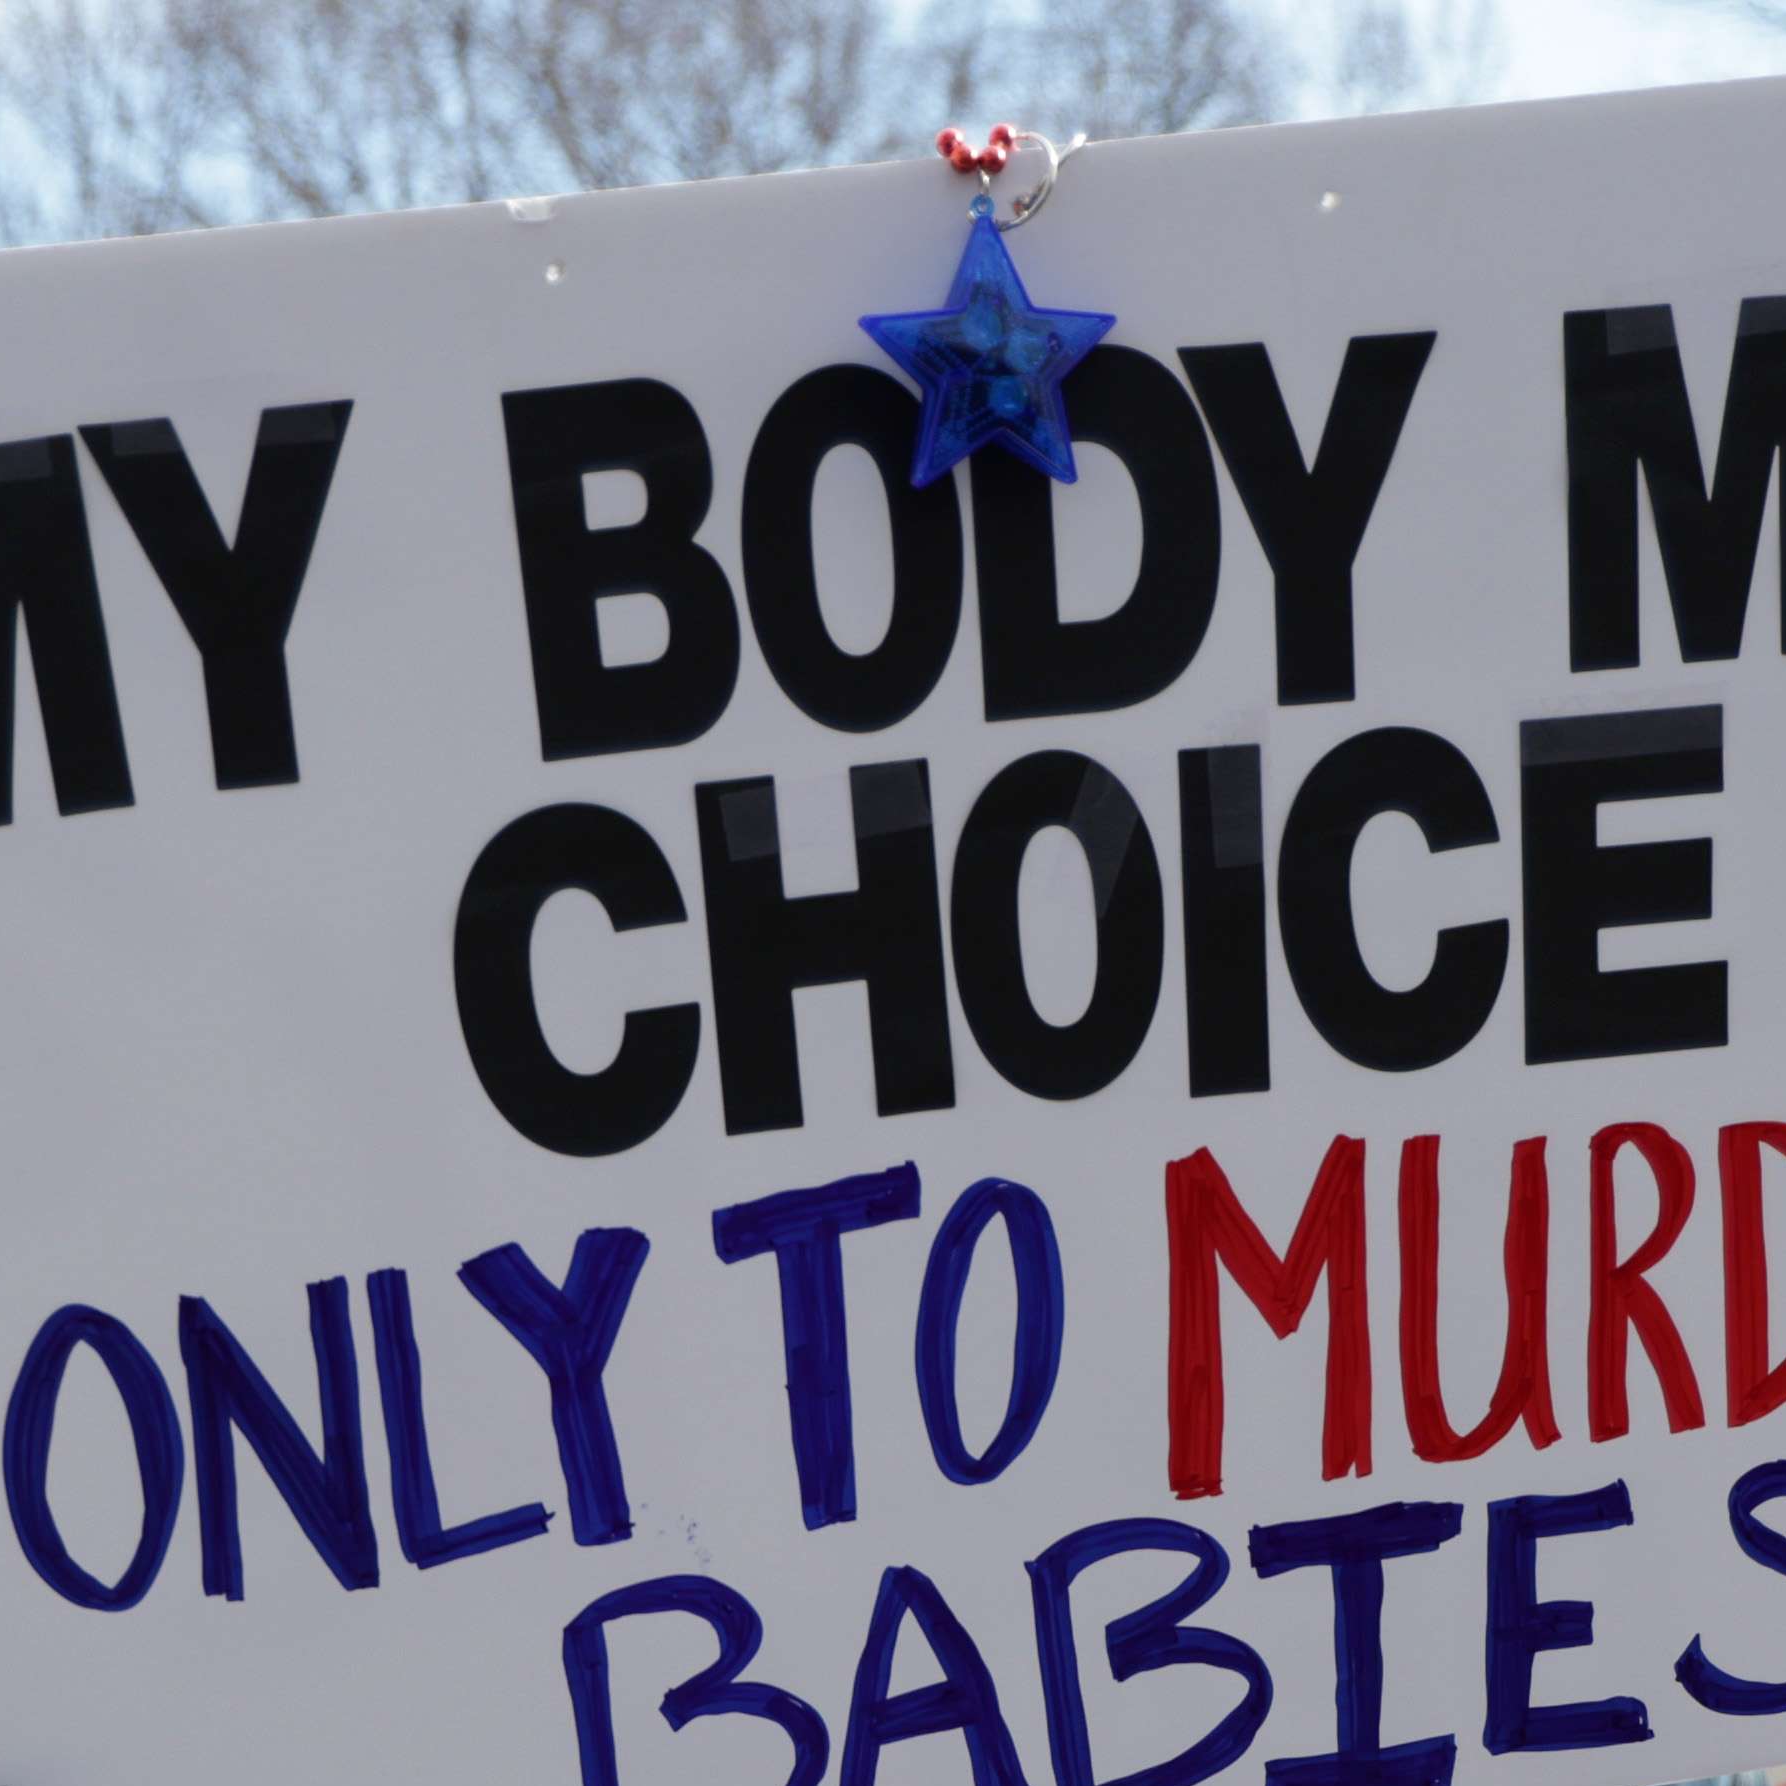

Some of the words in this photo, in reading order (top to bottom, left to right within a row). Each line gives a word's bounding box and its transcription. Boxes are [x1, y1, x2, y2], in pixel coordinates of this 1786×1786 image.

[500, 331, 1437, 762] BODY
[453, 704, 1728, 1157] CHOICE
[2, 1227, 651, 1612] ONLY
[712, 1160, 1065, 1531] TO
